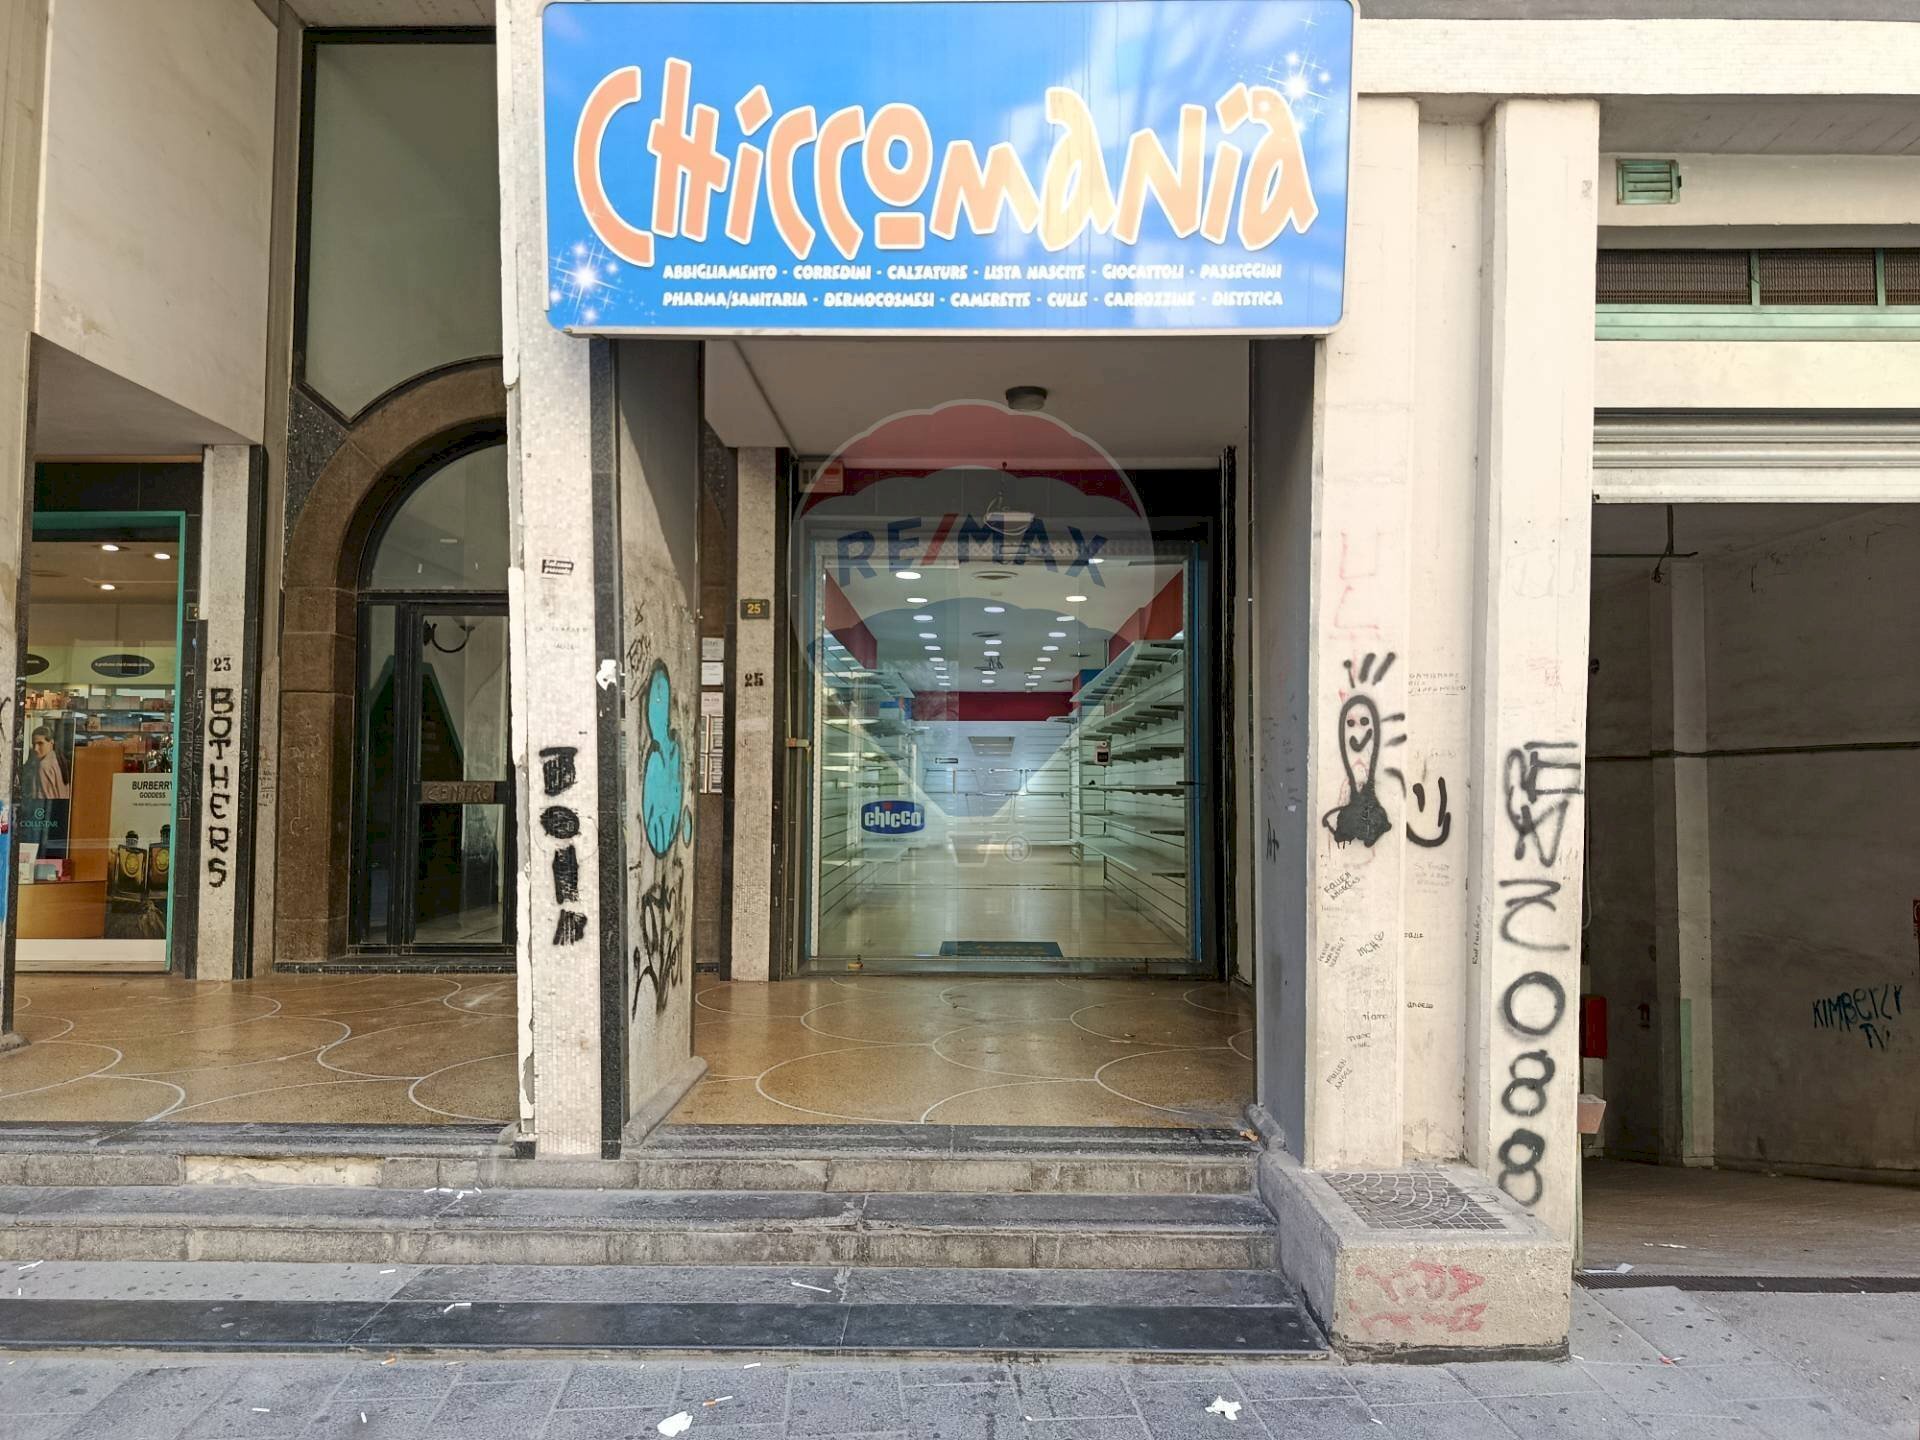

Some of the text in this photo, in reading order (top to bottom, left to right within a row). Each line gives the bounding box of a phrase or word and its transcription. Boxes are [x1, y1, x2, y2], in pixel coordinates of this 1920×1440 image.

[662, 263, 1282, 280] ABBIGLIAMENTO CORREDINI CALZATURE LISTA NASCITE GIOCATTOLI PASSEGGINI
[662, 291, 1284, 308] PHARMA/SANITARIA DERMOCOSMESI CAMERETTE CULLE CARROZZINE DIETETICA
[747, 603, 761, 614] 25
[213, 657, 233, 672] 23
[744, 671, 764, 688] 25
[139, 791, 167, 799] GODDESS
[864, 802, 922, 828] chicco
[20, 819, 59, 828] COLLISTAR
